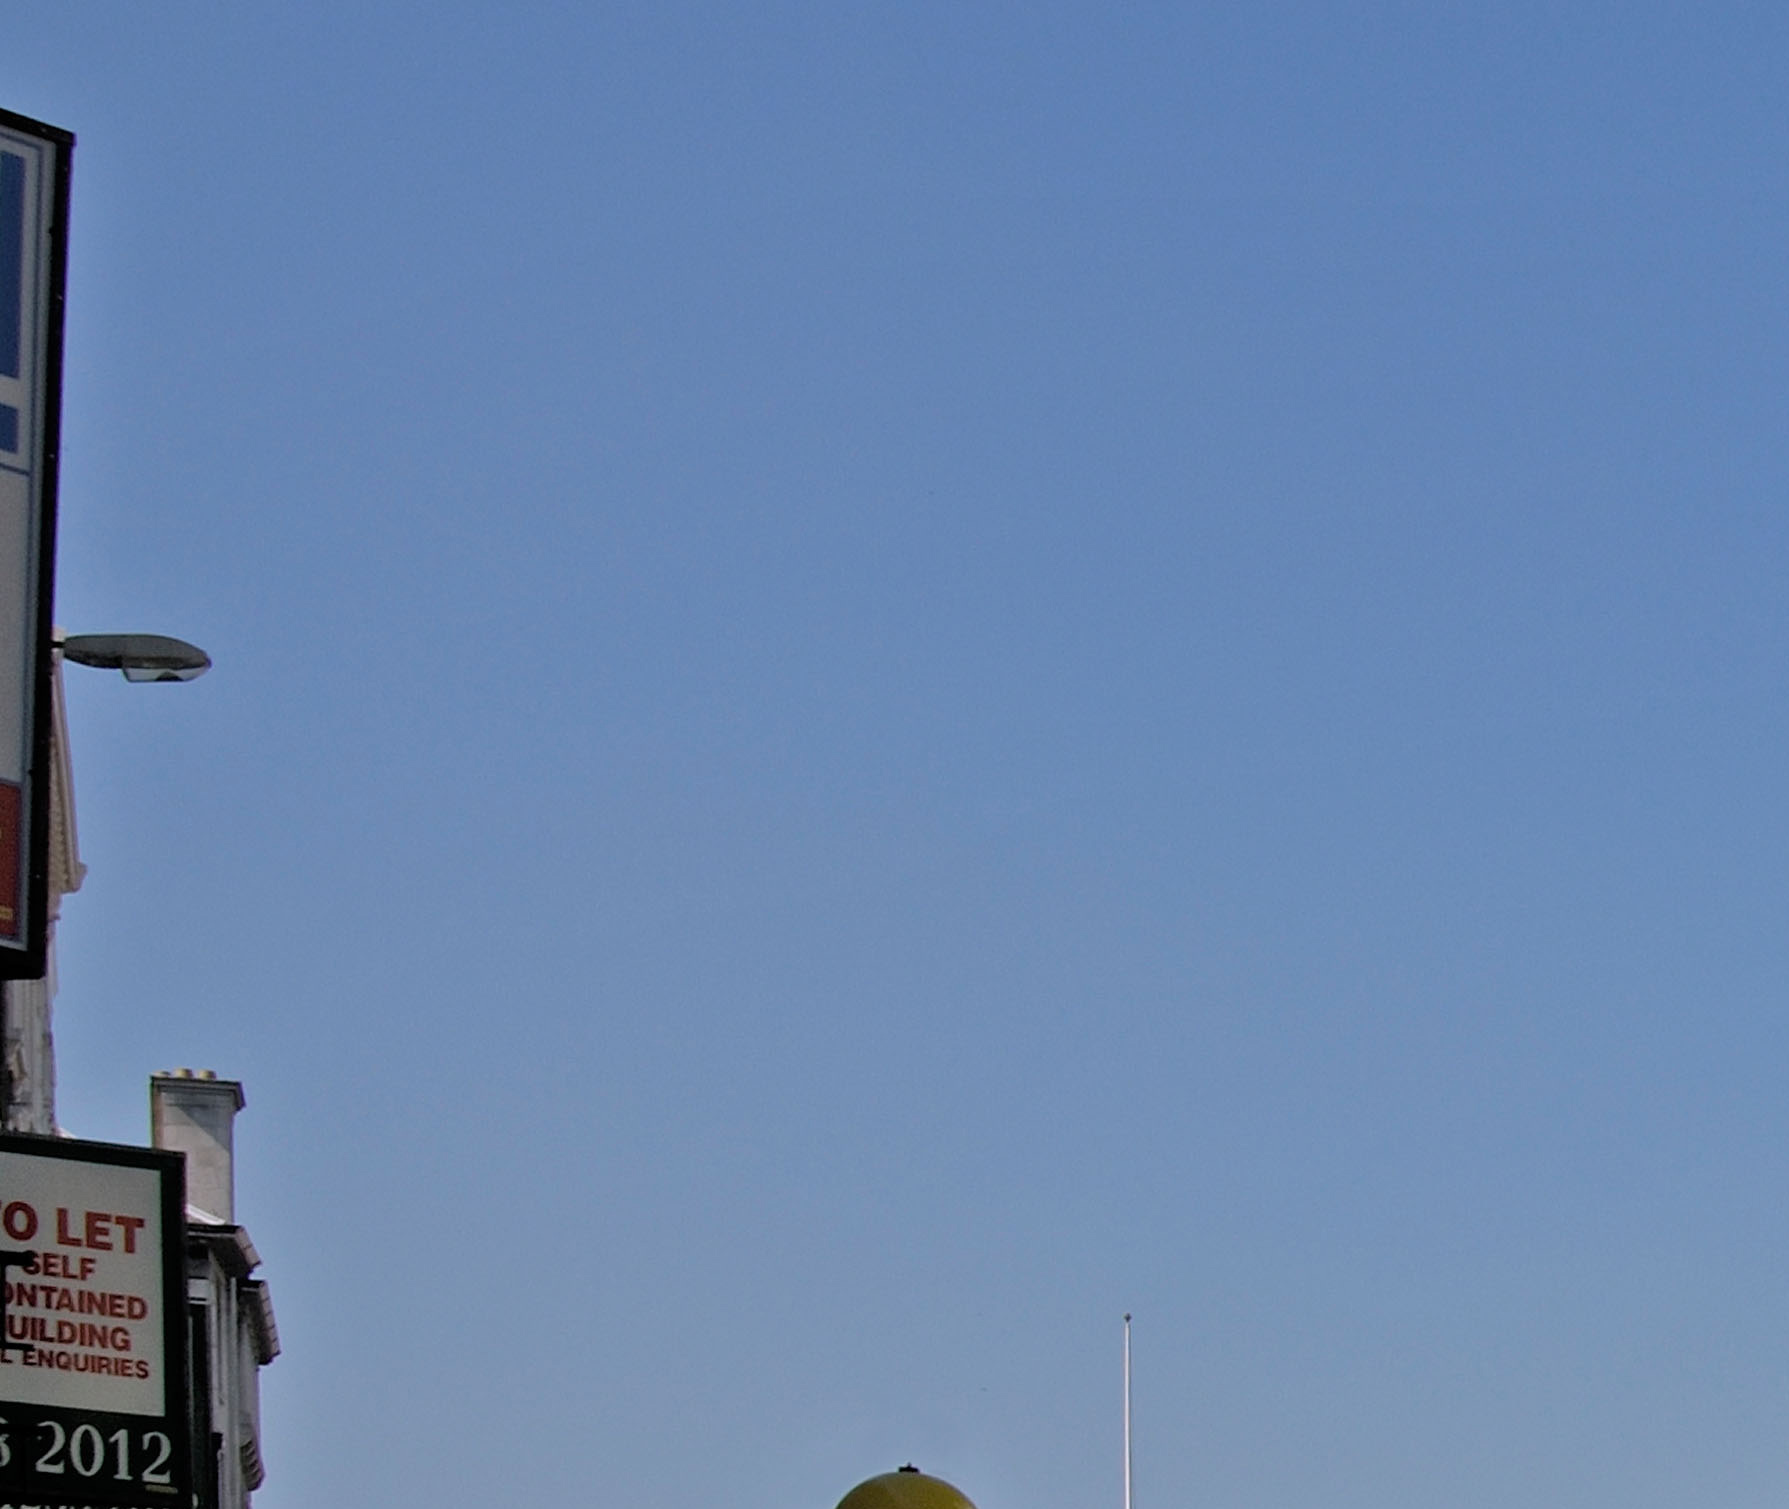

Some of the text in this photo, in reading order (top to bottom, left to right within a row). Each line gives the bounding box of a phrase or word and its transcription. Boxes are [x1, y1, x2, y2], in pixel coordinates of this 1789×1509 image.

[0, 1201, 145, 1254] O LET
[7, 1315, 132, 1351] UILDING
[23, 1348, 149, 1379] ENQUIRIES
[35, 1420, 171, 1484] 2012
